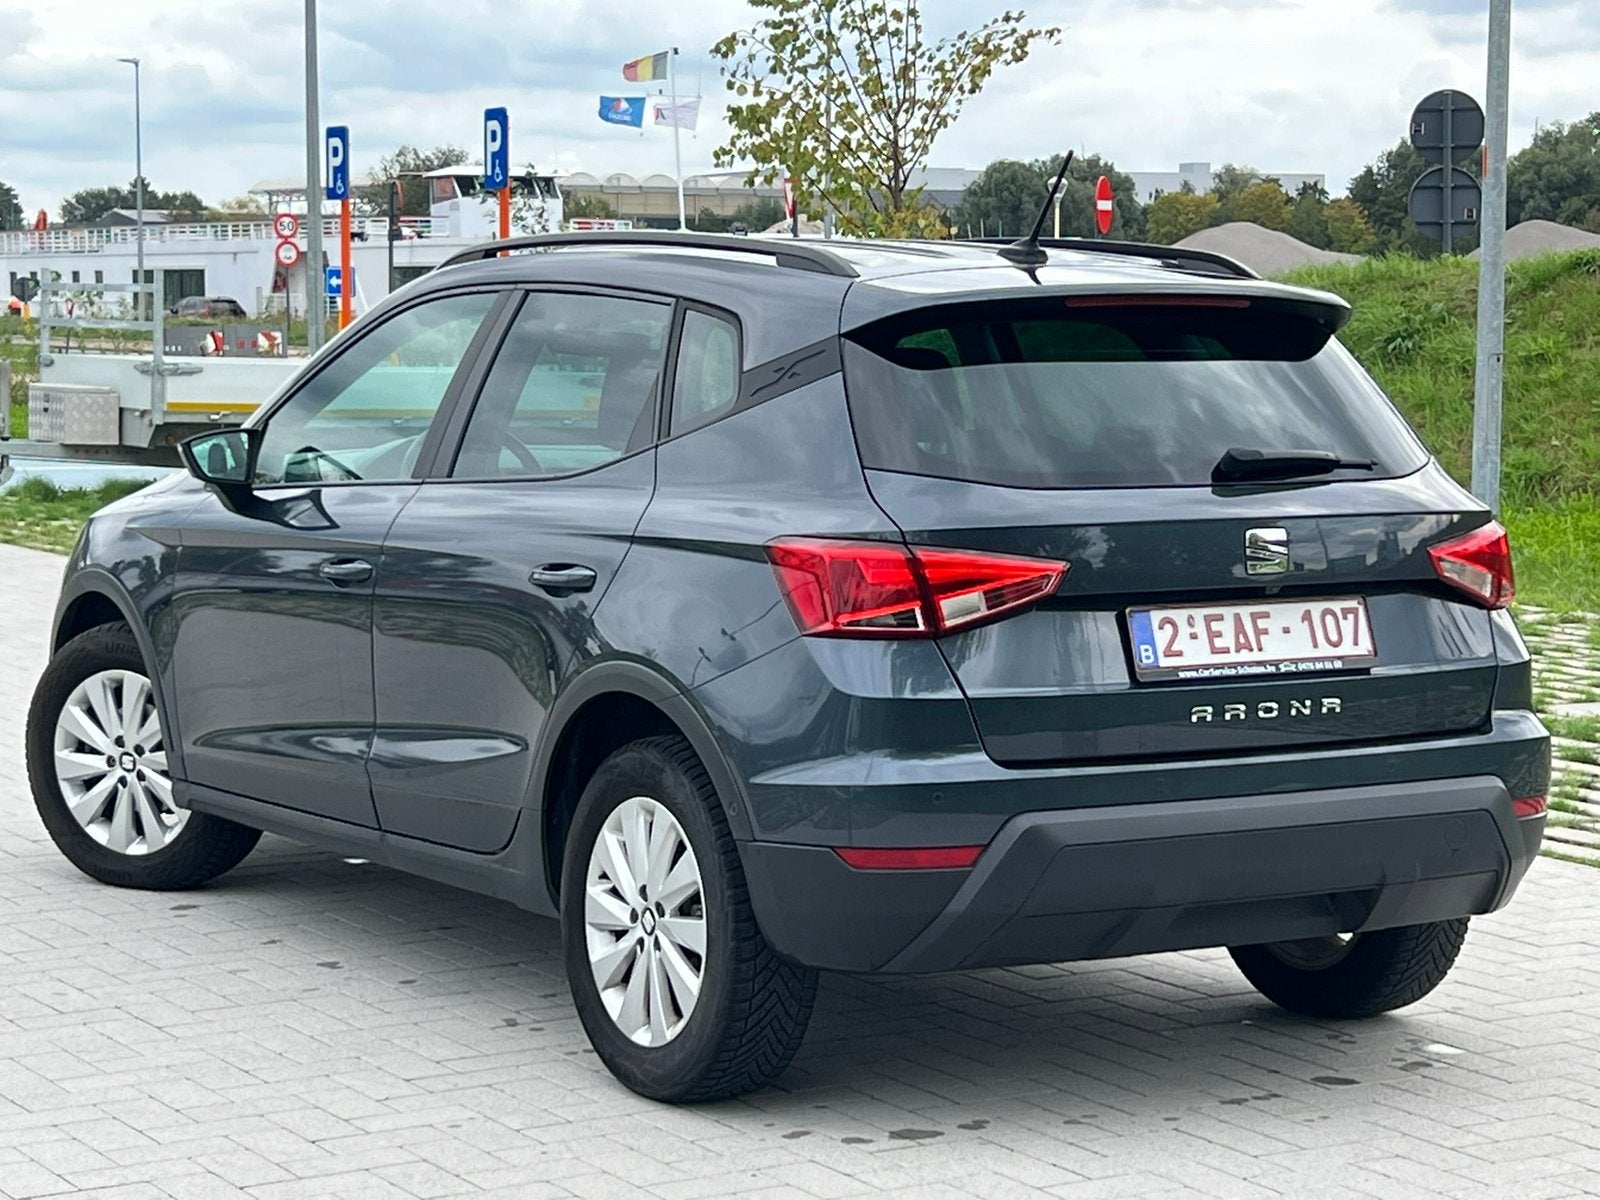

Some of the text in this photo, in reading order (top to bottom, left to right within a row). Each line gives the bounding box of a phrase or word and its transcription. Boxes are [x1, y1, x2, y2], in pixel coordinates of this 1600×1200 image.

[486, 119, 502, 177] P
[327, 136, 344, 189] P
[279, 220, 295, 232] 50
[1139, 644, 1154, 664] B
[1190, 697, 1342, 723] ARONA
